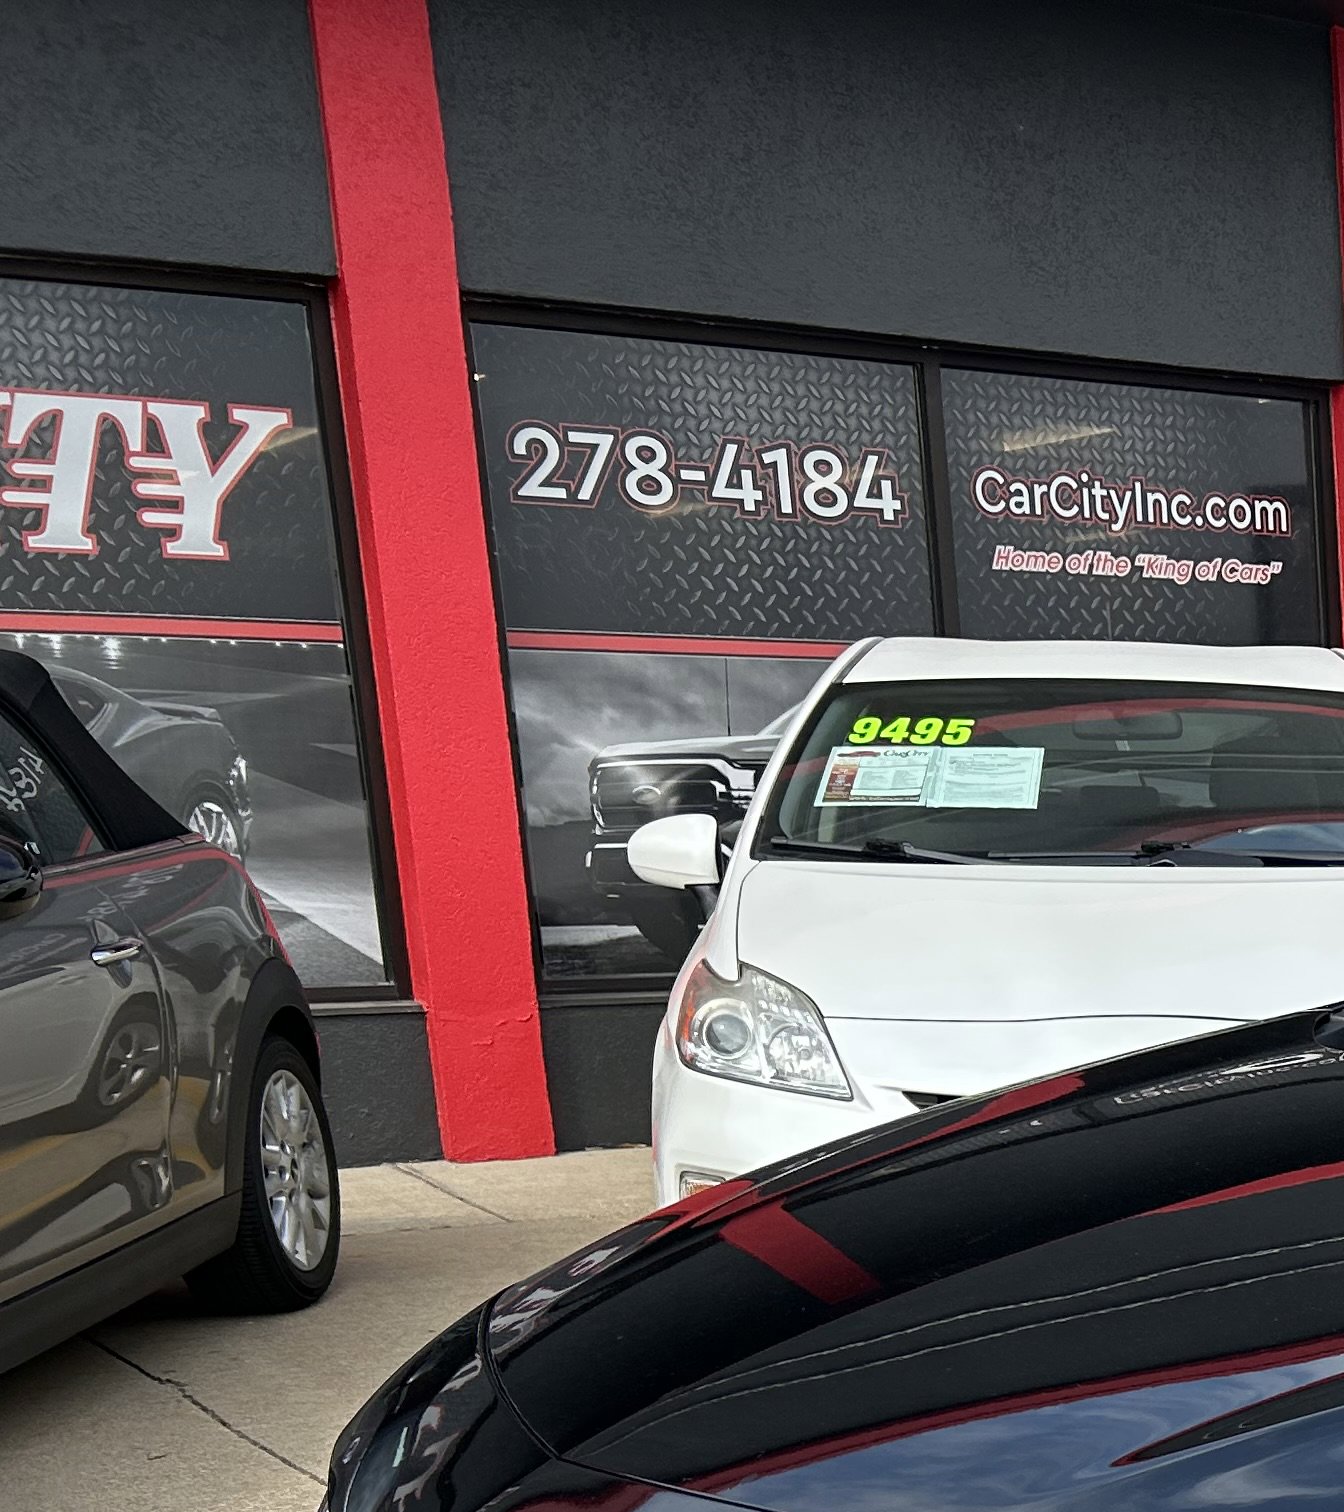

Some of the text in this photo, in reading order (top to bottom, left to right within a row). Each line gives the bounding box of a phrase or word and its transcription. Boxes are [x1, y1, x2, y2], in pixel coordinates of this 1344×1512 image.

[0, 388, 293, 561] TY
[508, 420, 906, 528] 278-4184
[972, 467, 1290, 535] CarCityInc.com
[992, 545, 1063, 573] Home
[1066, 551, 1092, 574] of
[1091, 551, 1131, 576] the
[1195, 559, 1219, 581] of
[848, 716, 976, 745] 9495
